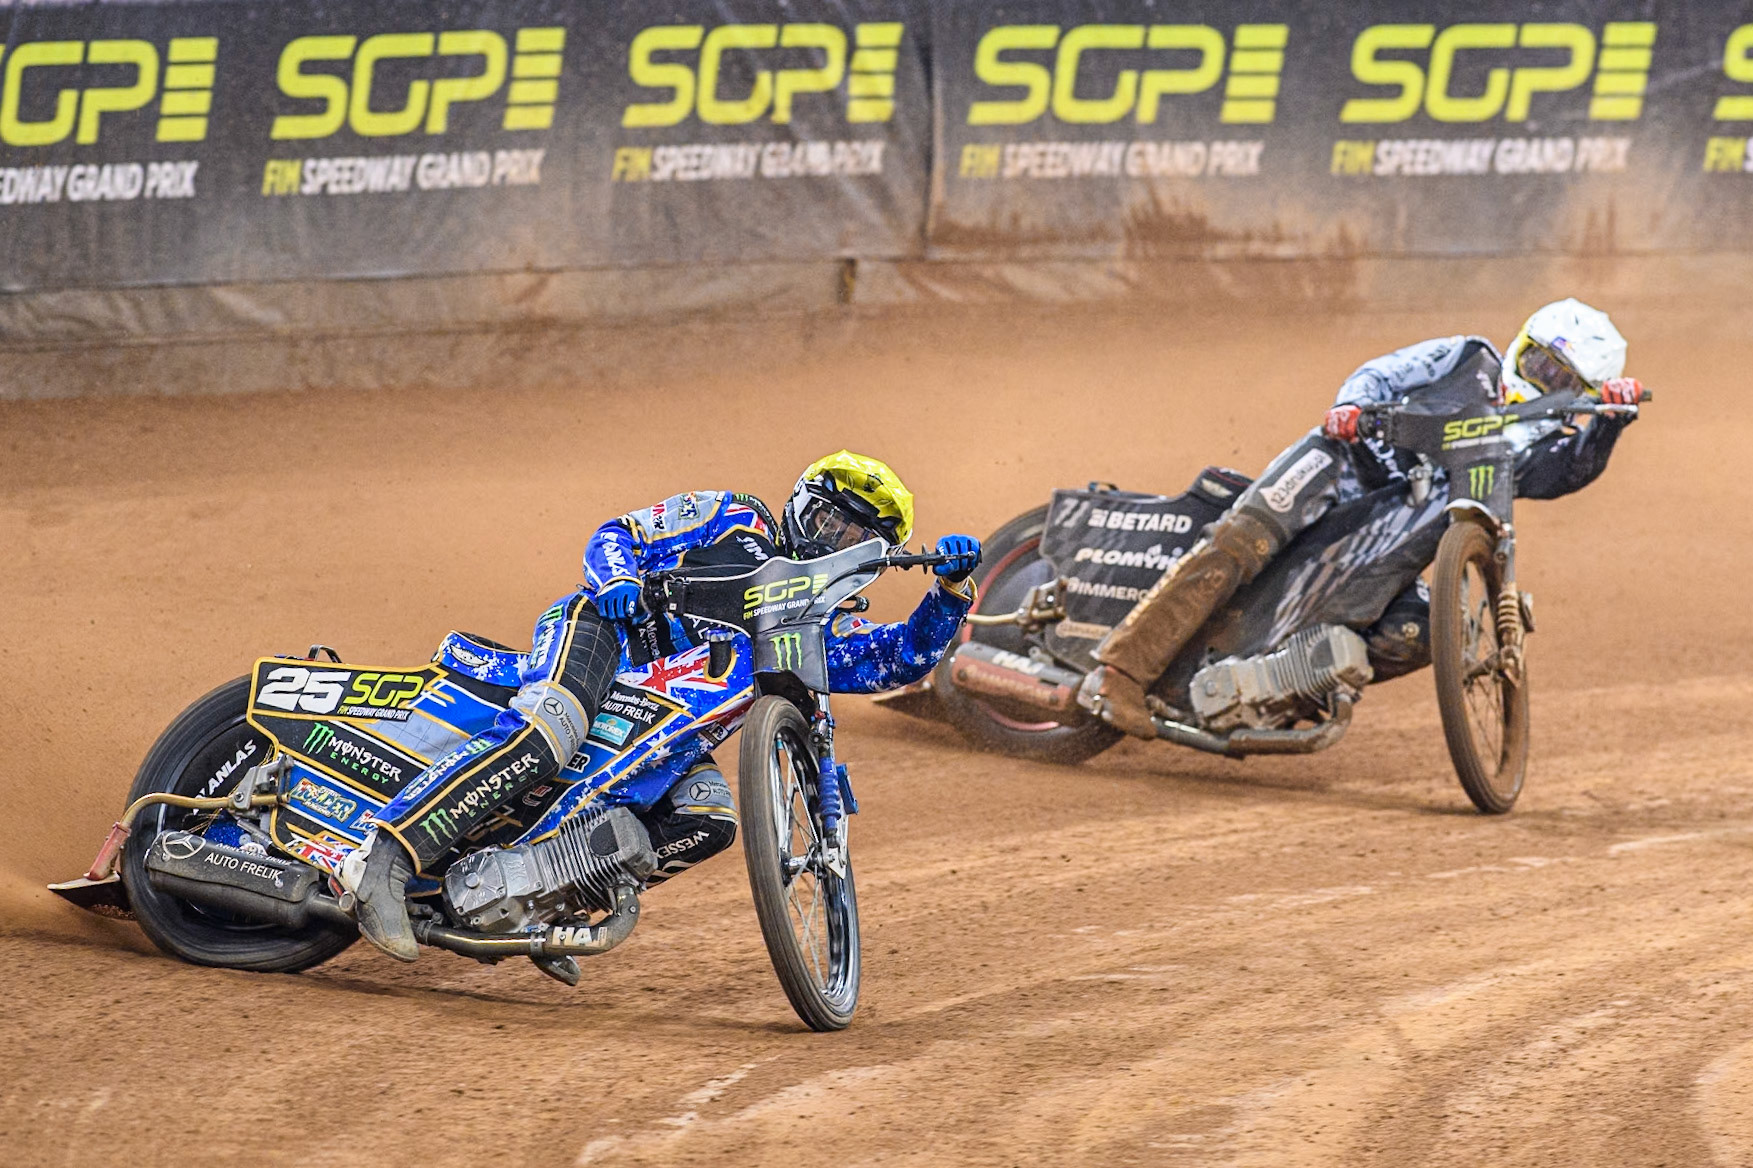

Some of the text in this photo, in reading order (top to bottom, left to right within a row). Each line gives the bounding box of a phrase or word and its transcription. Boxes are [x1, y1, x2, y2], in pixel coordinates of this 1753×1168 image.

[270, 29, 508, 140] SGP
[621, 23, 848, 128] SGP
[967, 24, 1226, 125] SGP
[1339, 22, 1597, 123] SGP
[0, 39, 159, 146] GP
[261, 148, 546, 196] FIM SPEEDWAY GRAND PRIX
[1000, 140, 1127, 178] SPEEDWAY
[1125, 140, 1207, 177] GRAND
[1206, 139, 1265, 176] PRIX
[1373, 138, 1497, 176] SPEEDWAY
[1495, 137, 1574, 175] GRAND
[1574, 136, 1633, 173] PRIX
[67, 162, 144, 201] GRAND
[144, 160, 199, 198] PRIX
[1443, 415, 1503, 441] SGP
[1106, 510, 1192, 534] BETARD
[743, 576, 811, 609] SGP
[754, 603, 787, 617] SPEEDWAY
[256, 667, 351, 714] 25
[343, 672, 425, 709] SGP
[347, 706, 379, 717] SPEEDWAY
[375, 707, 396, 719] GRAND
[394, 710, 410, 720] PRIX
[559, 718, 571, 735] AUTO
[601, 700, 656, 725] AUTO FRELIK
[330, 751, 389, 784] ENERGY
[468, 766, 538, 818] ENERGY
[204, 852, 282, 880] AUTO FRELIK
